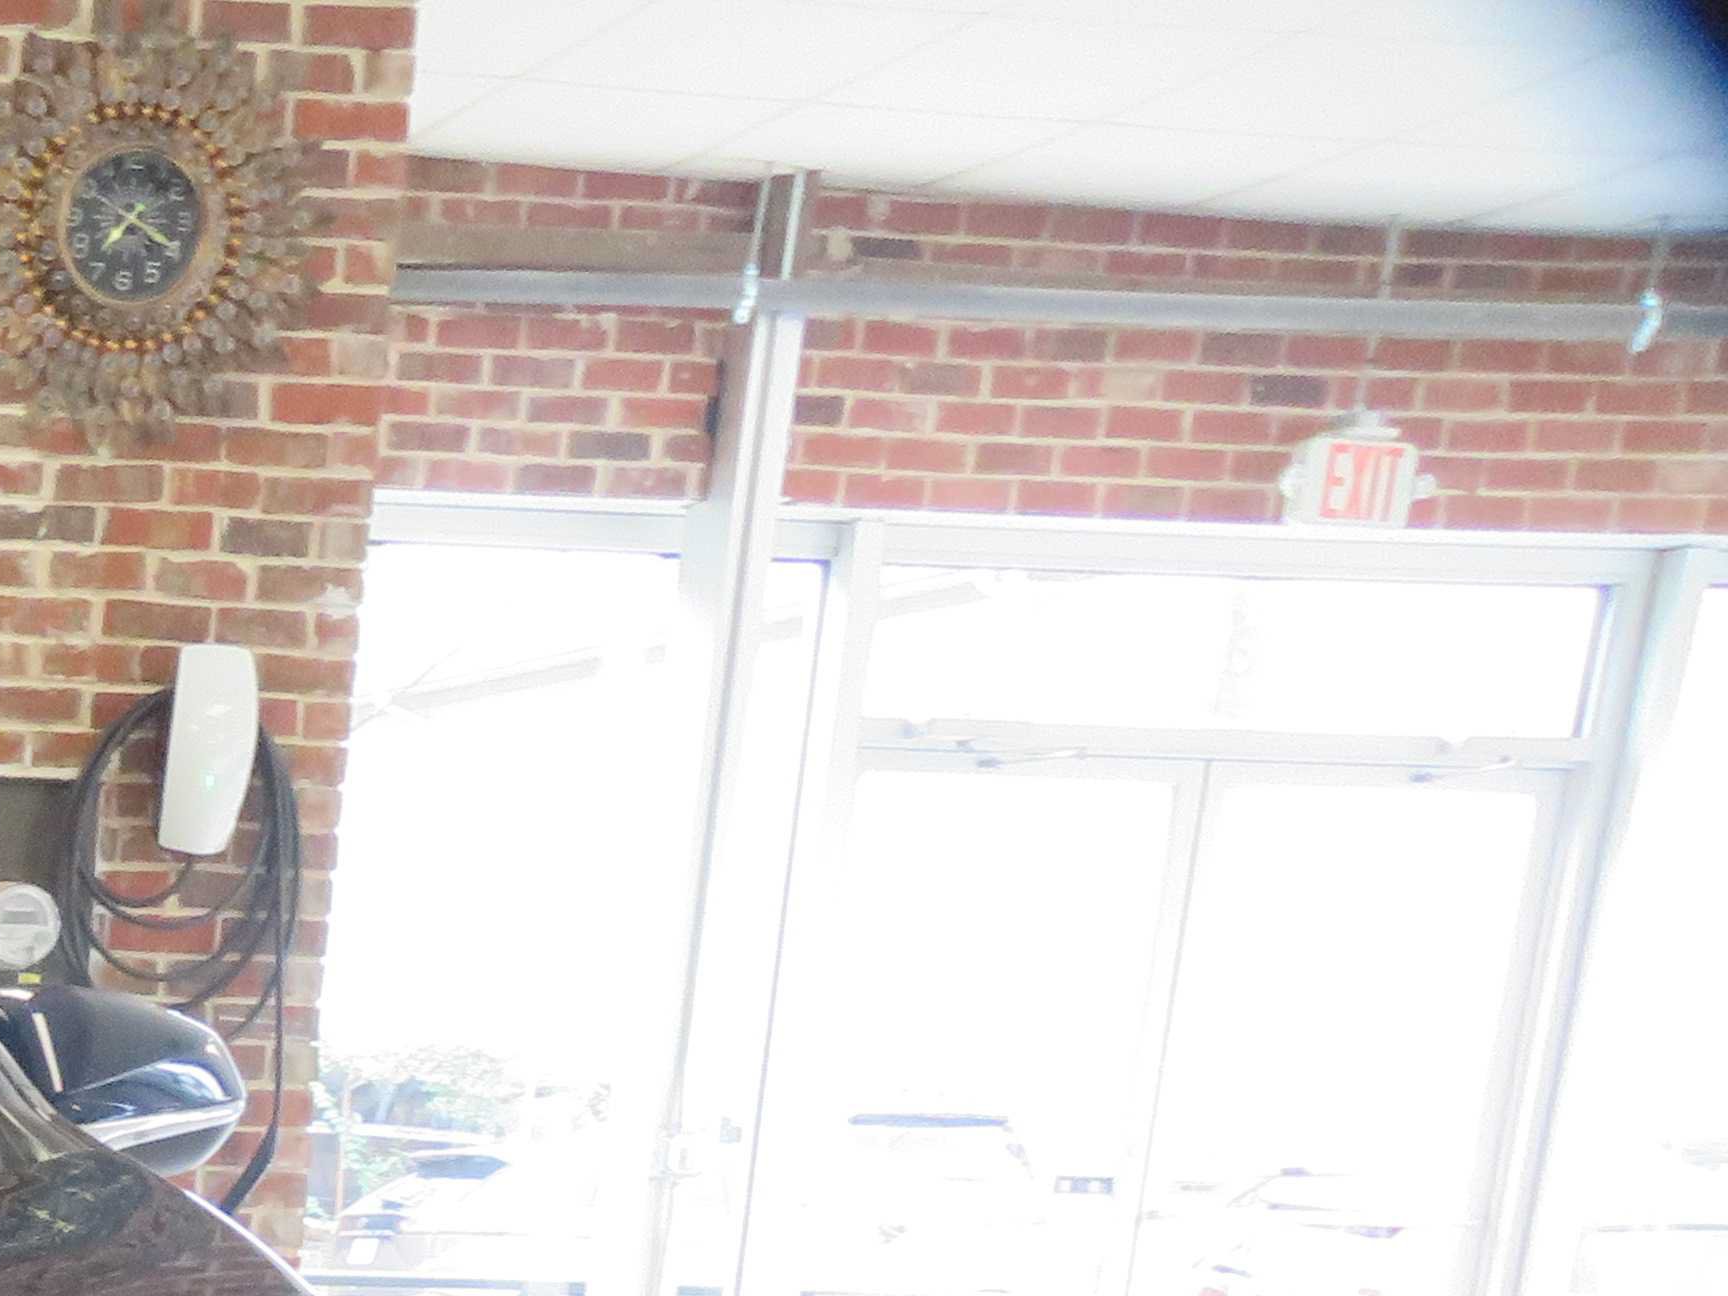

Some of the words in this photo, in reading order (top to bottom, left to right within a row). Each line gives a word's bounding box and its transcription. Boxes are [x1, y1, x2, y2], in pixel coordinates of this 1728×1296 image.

[89, 262, 106, 281] 7
[112, 270, 133, 292] 6
[144, 261, 162, 284] 5
[1319, 443, 1405, 521] EXIT
